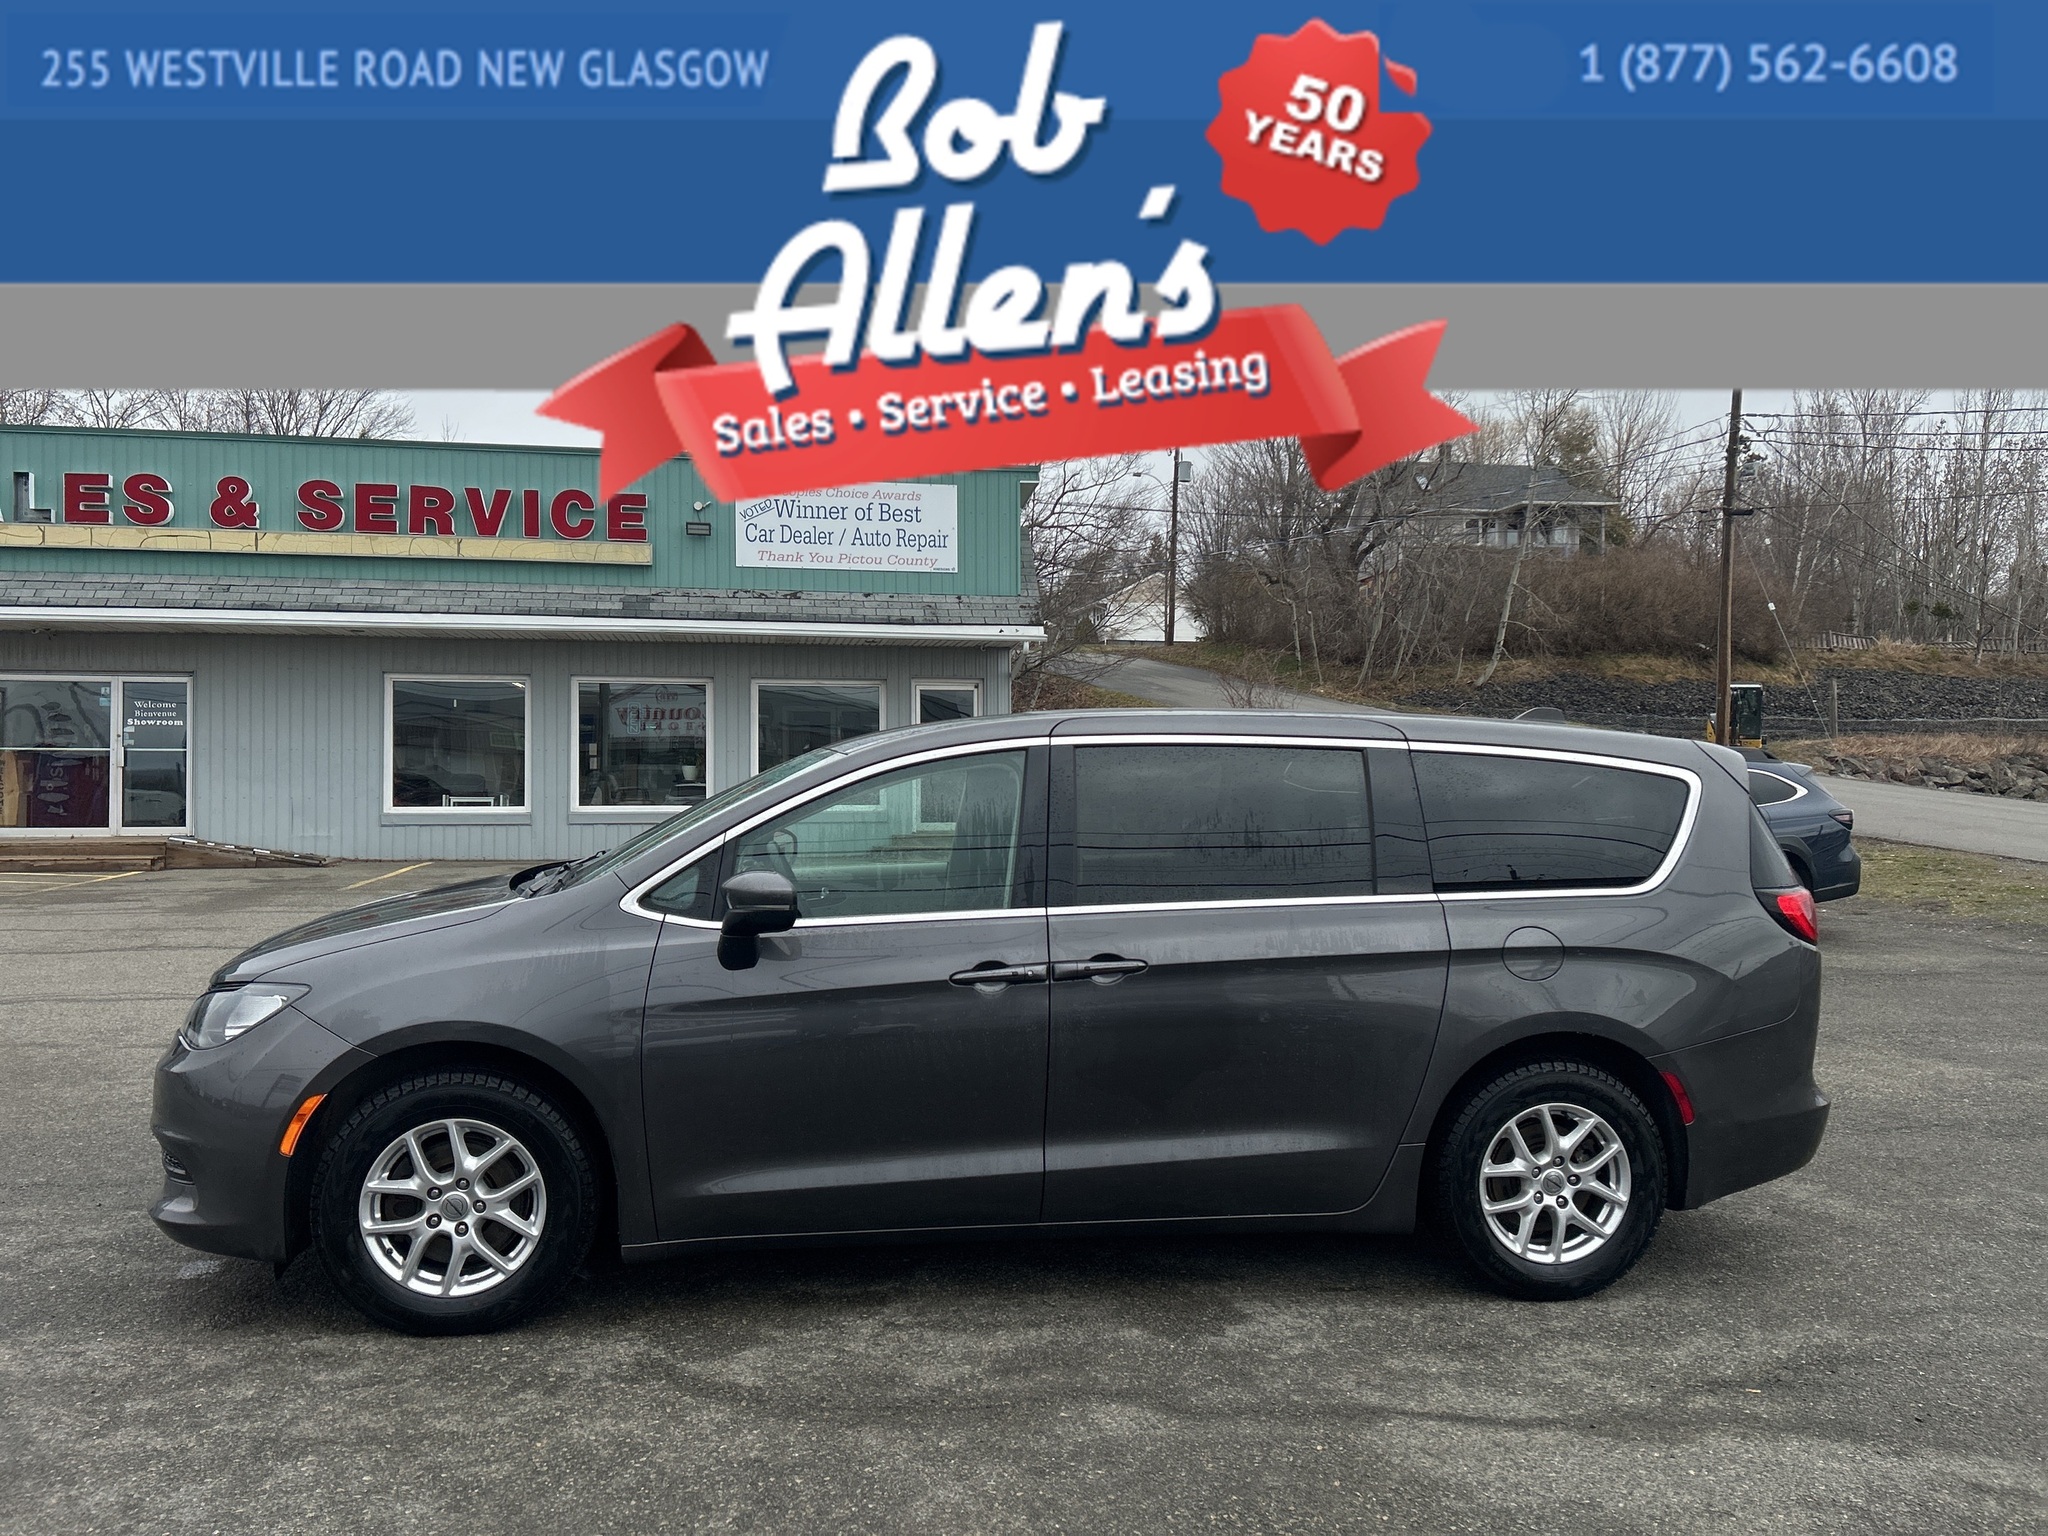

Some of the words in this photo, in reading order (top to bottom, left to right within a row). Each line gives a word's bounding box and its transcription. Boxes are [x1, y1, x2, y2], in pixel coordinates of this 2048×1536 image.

[781, 487, 823, 499] eoples
[825, 487, 869, 500] Choice
[872, 488, 922, 501] Awards
[0, 470, 175, 526] LES
[208, 475, 260, 529] &
[296, 478, 649, 542] SERVICE
[739, 498, 773, 521] VOTED
[773, 498, 849, 521] Winner
[854, 501, 875, 522] of
[878, 503, 922, 523] Best
[745, 522, 775, 544] Car
[779, 524, 835, 546] Dealer
[838, 527, 847, 547] /
[851, 526, 892, 548] Auto
[895, 528, 949, 552] Repair
[757, 550, 804, 563] Thank
[808, 551, 834, 564] You
[837, 553, 882, 566] Pictou
[887, 554, 938, 569] County
[134, 701, 177, 709] Welcome
[134, 710, 177, 718] Bienvenue
[126, 718, 184, 726] Showroom
